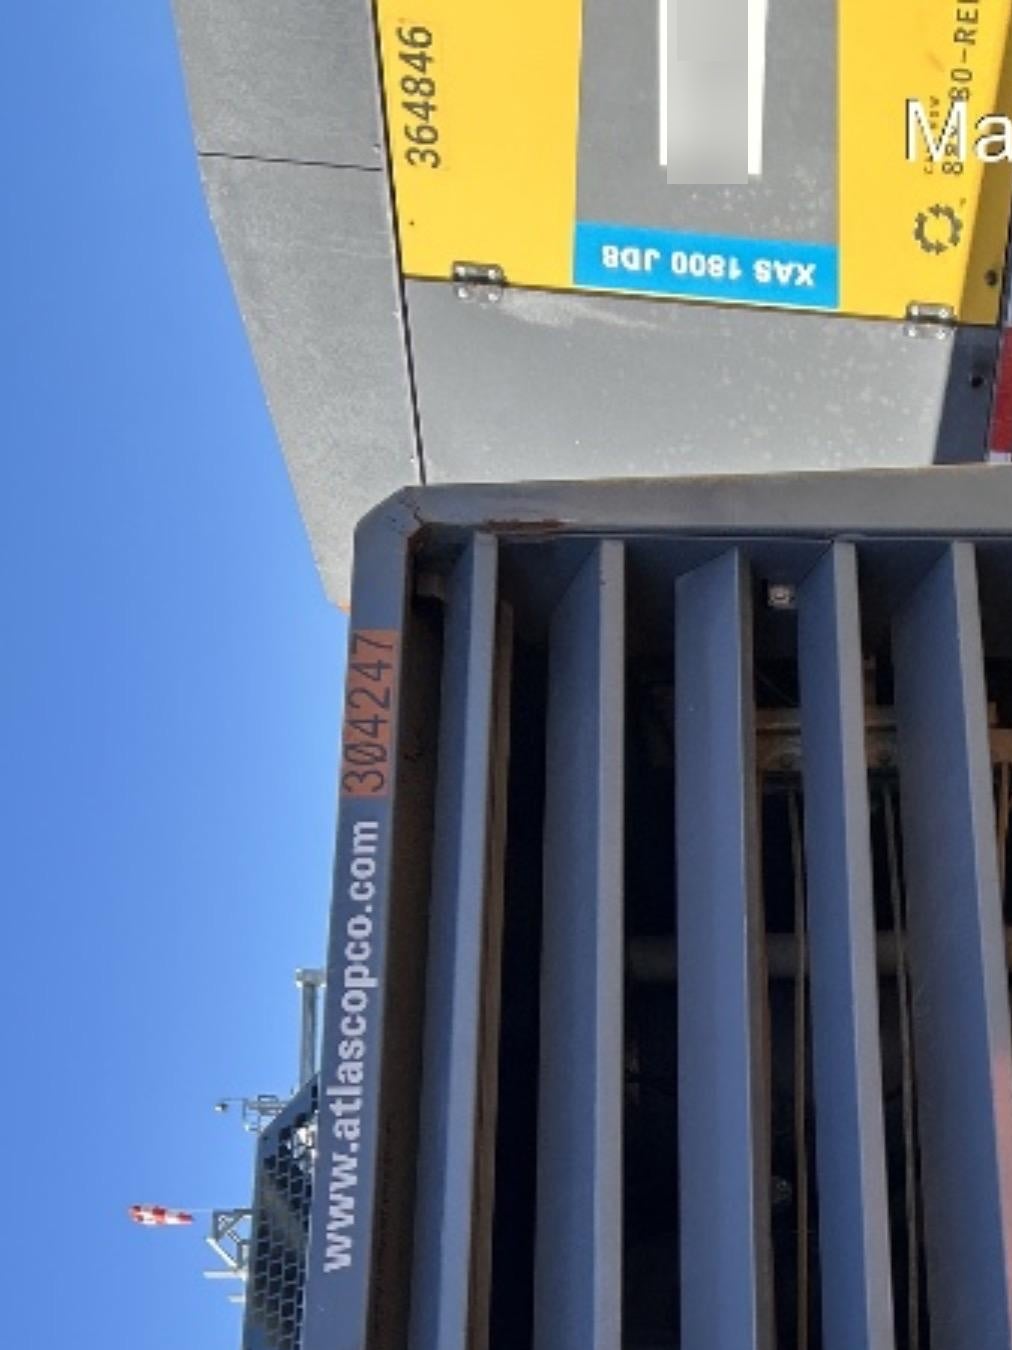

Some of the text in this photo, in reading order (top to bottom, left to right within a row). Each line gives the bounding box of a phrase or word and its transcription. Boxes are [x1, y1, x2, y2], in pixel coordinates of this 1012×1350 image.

[396, 26, 441, 169] 364846
[671, 250, 743, 281] 1800
[753, 259, 817, 287] XAS
[342, 632, 393, 793] 304247
[323, 821, 379, 1273] www.atlascopco.com
